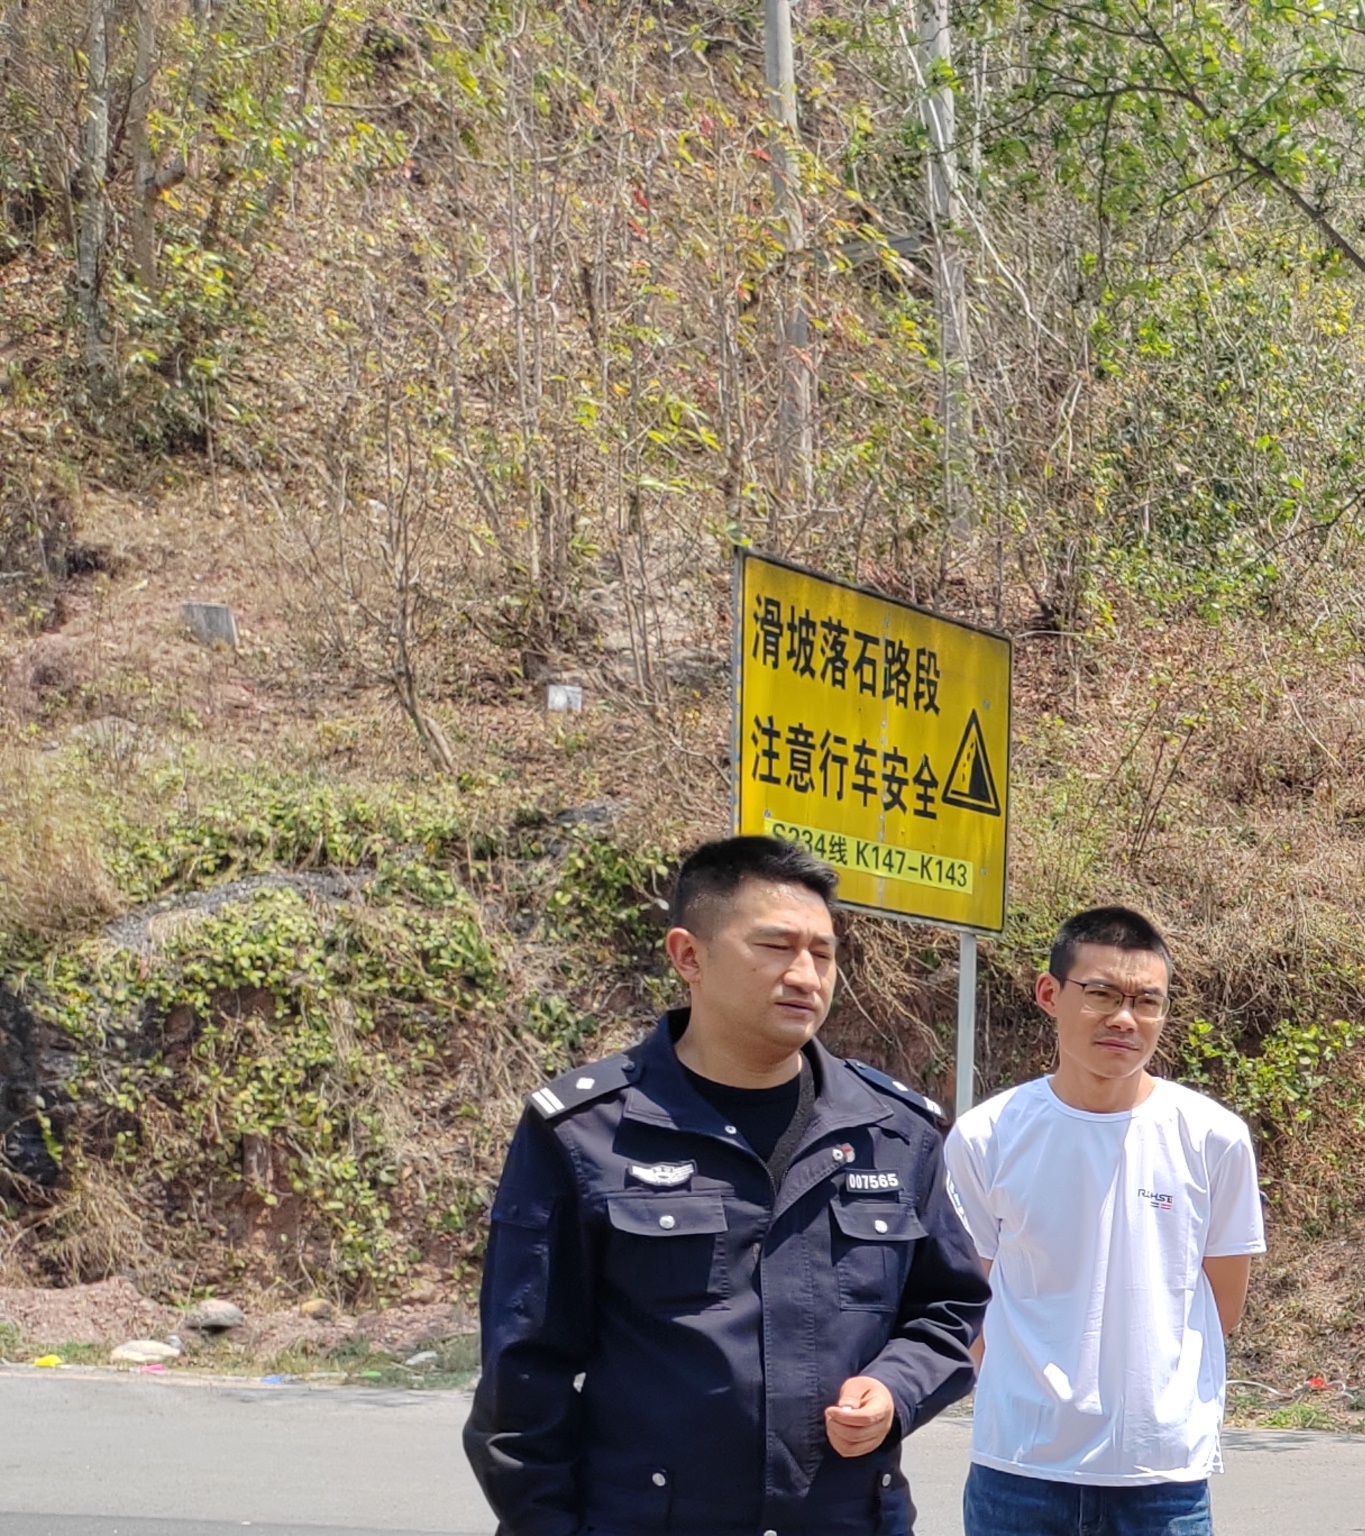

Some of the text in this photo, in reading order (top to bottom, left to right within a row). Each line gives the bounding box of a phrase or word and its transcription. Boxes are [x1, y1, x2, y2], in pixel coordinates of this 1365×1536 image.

[751, 593, 941, 716] 滑坡落石路段
[751, 714, 939, 820] 注意行车安全
[856, 841, 968, 888] K147-K143
[848, 1173, 899, 1190] 007565
